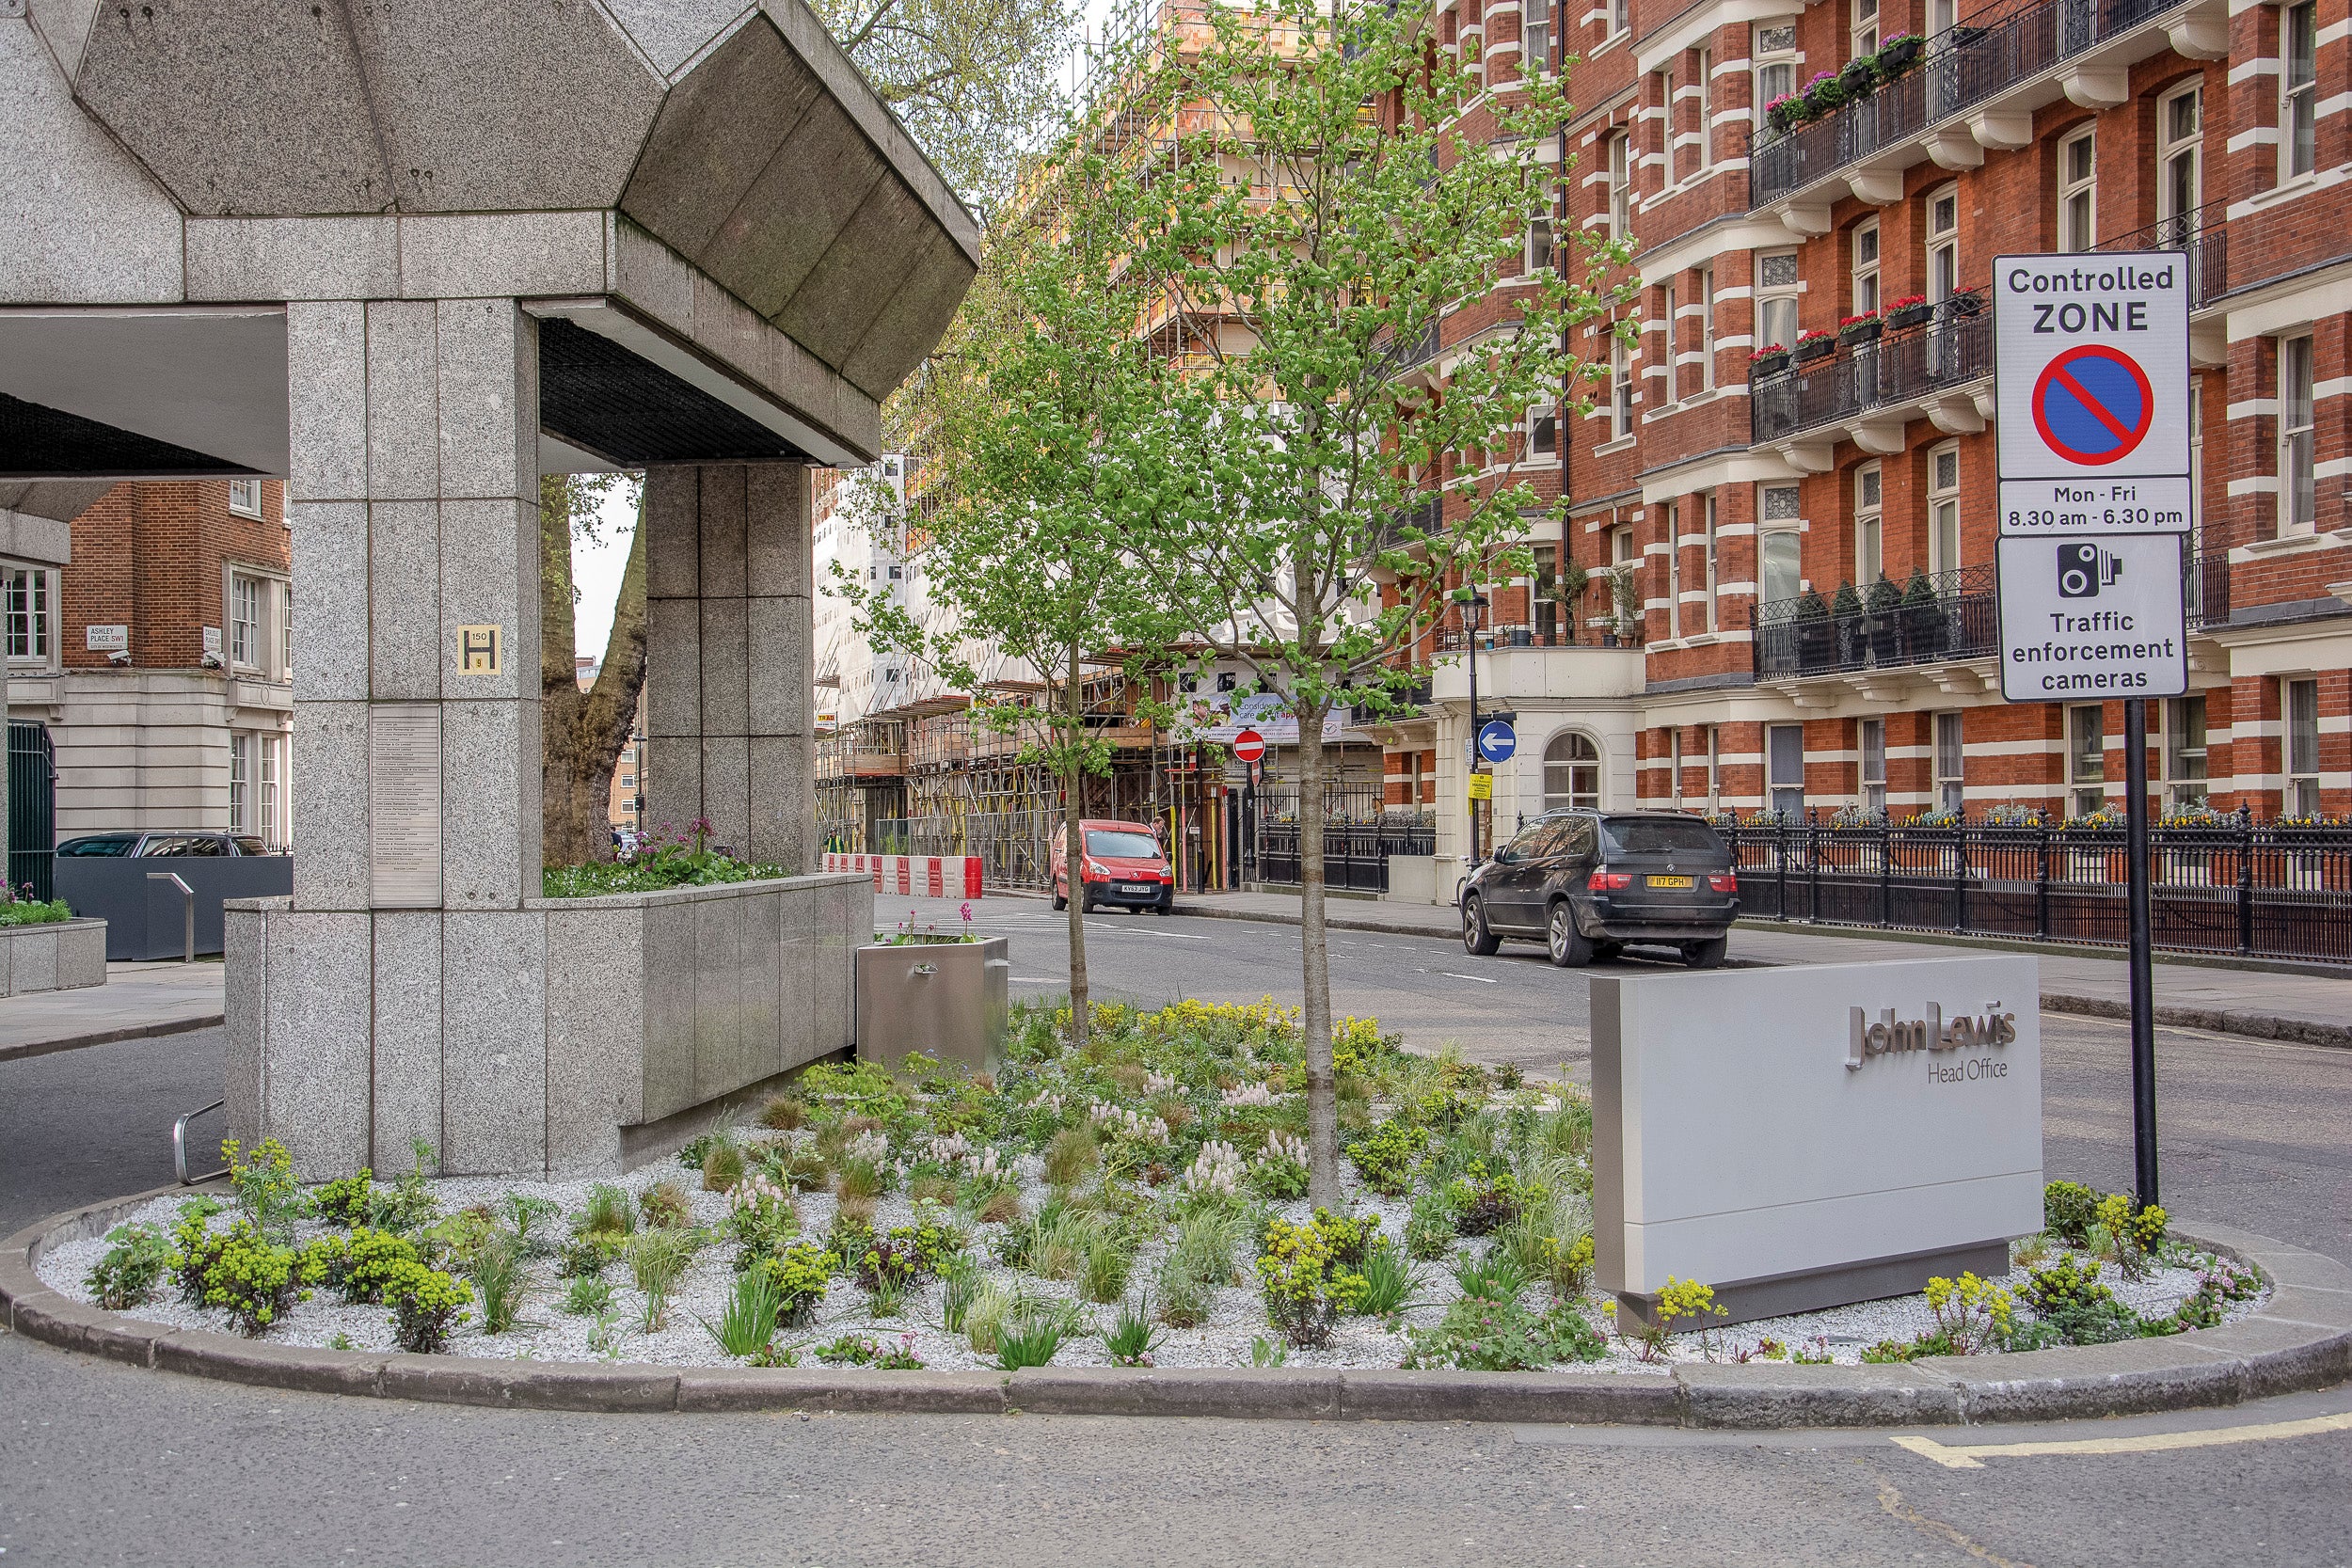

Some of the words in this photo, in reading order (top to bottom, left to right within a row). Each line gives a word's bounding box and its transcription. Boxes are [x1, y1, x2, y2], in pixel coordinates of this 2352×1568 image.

[2009, 264, 2173, 293] Controlled
[2033, 301, 2148, 334] ZONE
[2054, 487, 2094, 503] Mon
[2111, 485, 2136, 501] Fri
[2009, 510, 2055, 527] 8.30
[2059, 513, 2087, 525] am
[2103, 508, 2149, 525] 6.30
[2153, 511, 2183, 526] pm
[2050, 611, 2135, 633] Traffic
[463, 630, 495, 670] H
[2012, 638, 2173, 663] enforcement
[2042, 671, 2148, 690] cameras
[1669, 878, 1684, 886] GPH
[1844, 1006, 1927, 1070] John
[1926, 1000, 2016, 1050] Lewis
[1928, 1061, 1963, 1084] Head
[1967, 1058, 2008, 1081] Office
